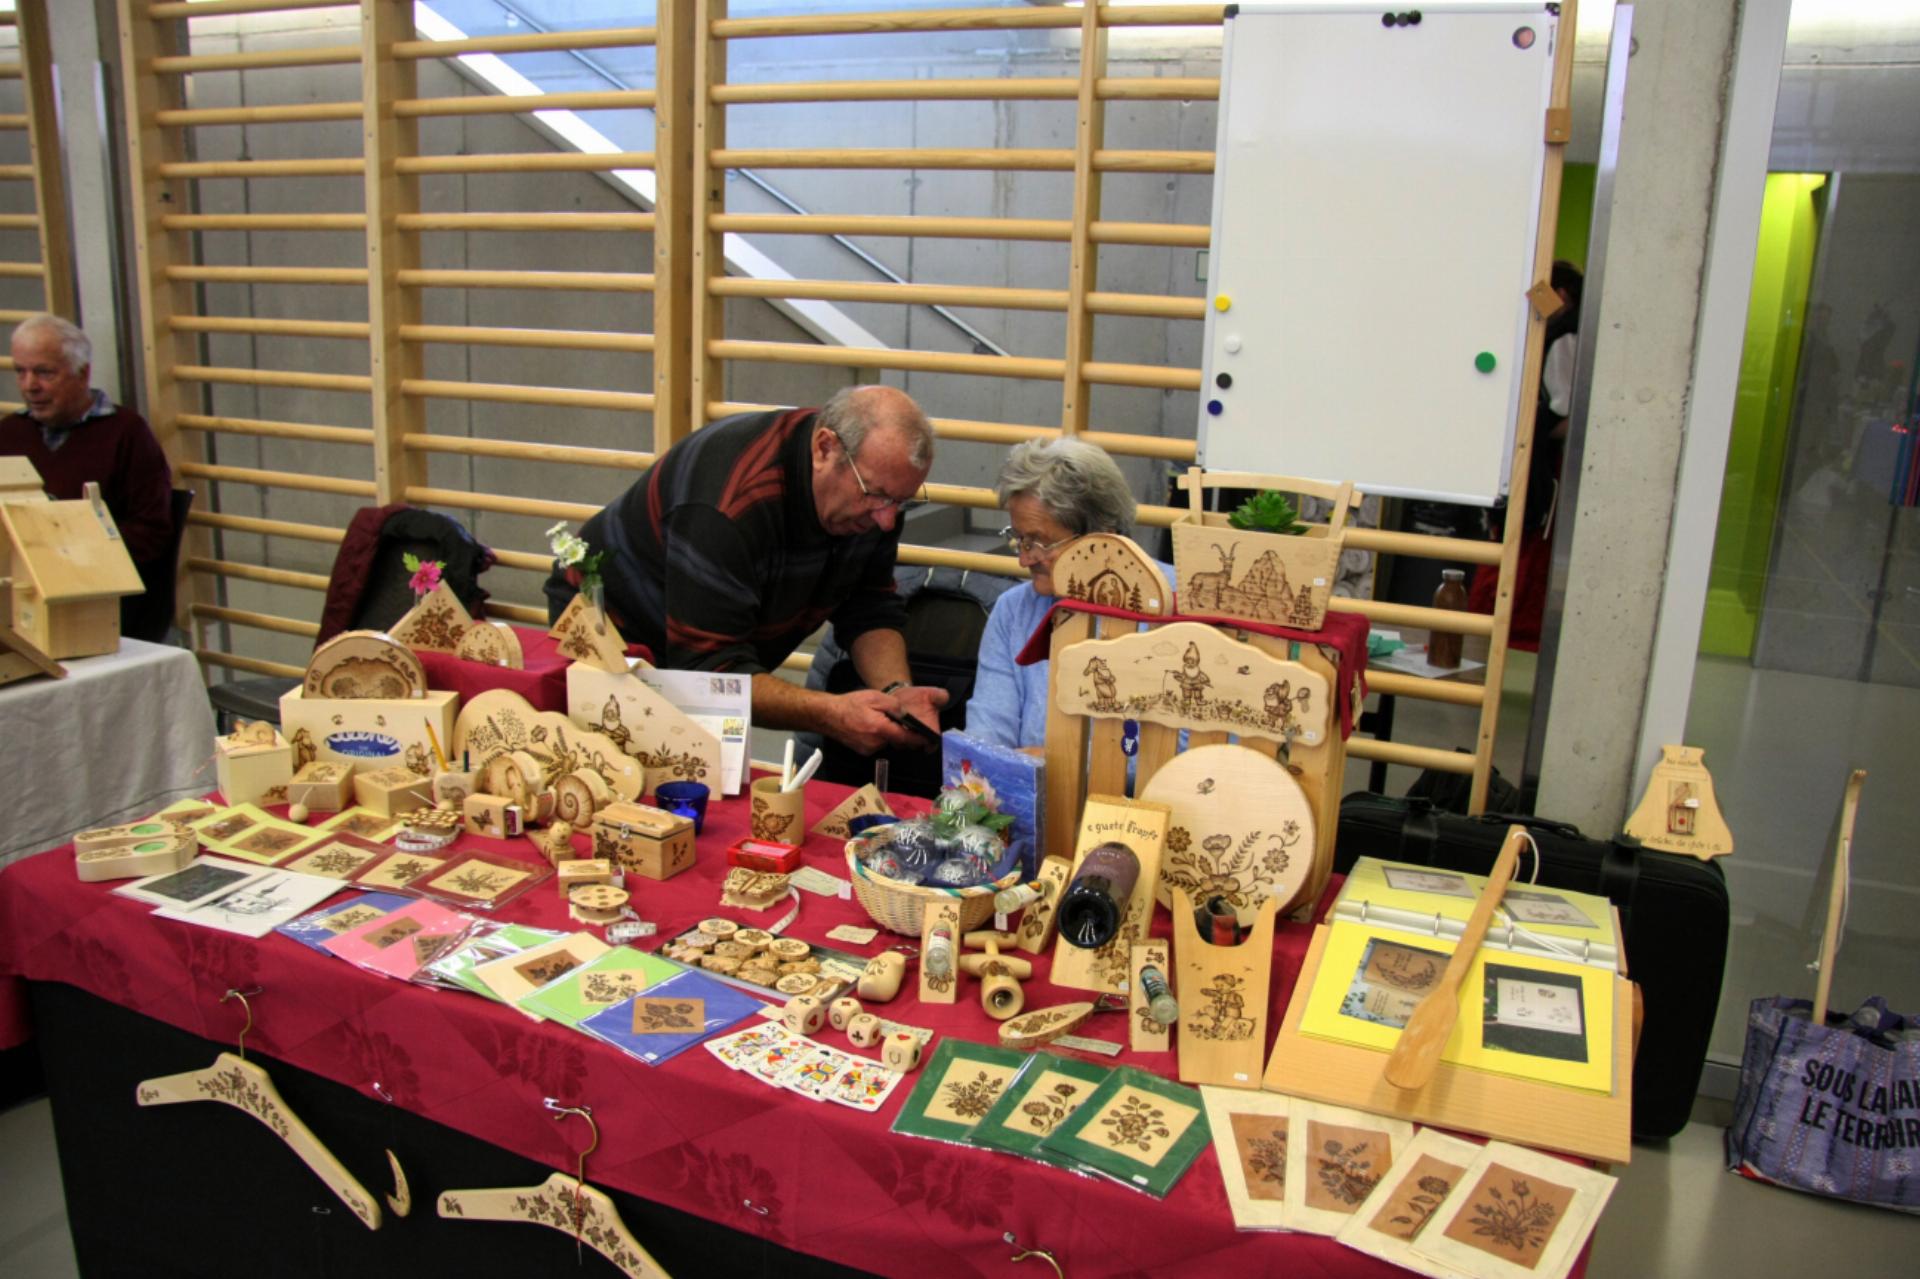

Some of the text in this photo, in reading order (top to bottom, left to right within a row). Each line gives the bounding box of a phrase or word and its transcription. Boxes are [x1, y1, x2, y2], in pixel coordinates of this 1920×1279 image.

[1801, 1059, 1856, 1102] SOUS
[1858, 1080, 1887, 1116] LA
[1800, 1096, 1832, 1130] LE
